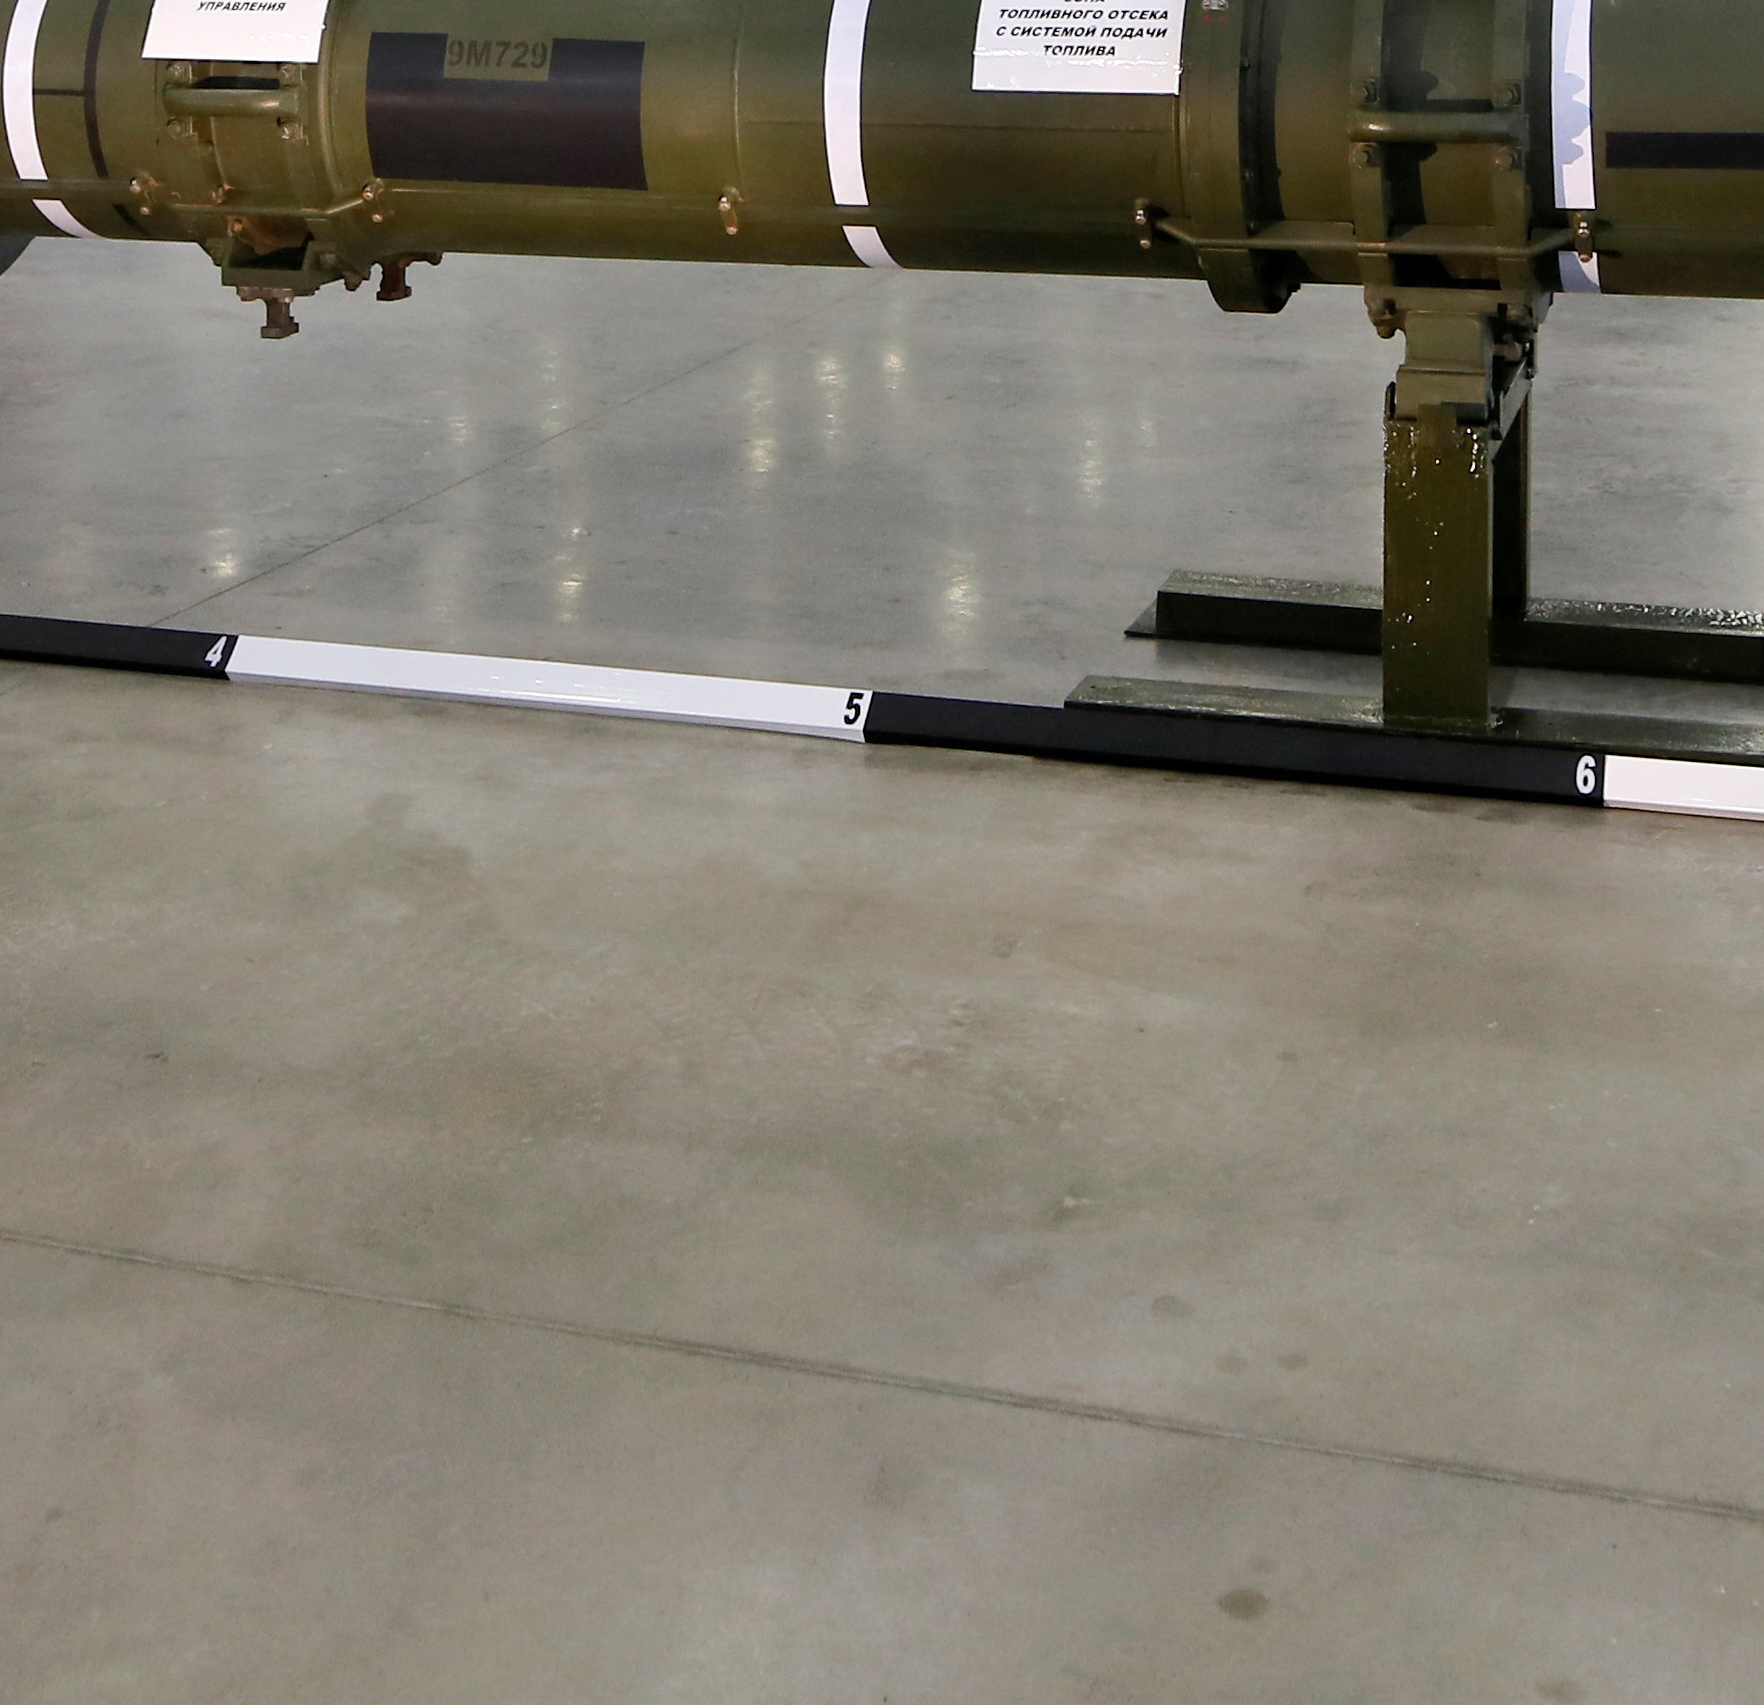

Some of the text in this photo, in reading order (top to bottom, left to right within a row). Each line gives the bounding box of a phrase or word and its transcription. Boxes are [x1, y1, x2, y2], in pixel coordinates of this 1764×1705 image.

[197, 1, 287, 12] УПРАВЛЕНИЯ
[999, 8, 1169, 21] ТОПЛИВНОГО ОТСЕКА
[995, 24, 1169, 40] С СИСТЕМОЙ ПОДАЧИ
[447, 39, 551, 70] 9М729
[1043, 44, 1116, 57] ТОПЛИВА
[205, 635, 228, 667] 4
[844, 691, 865, 725] 5
[1575, 755, 1596, 795] 6
